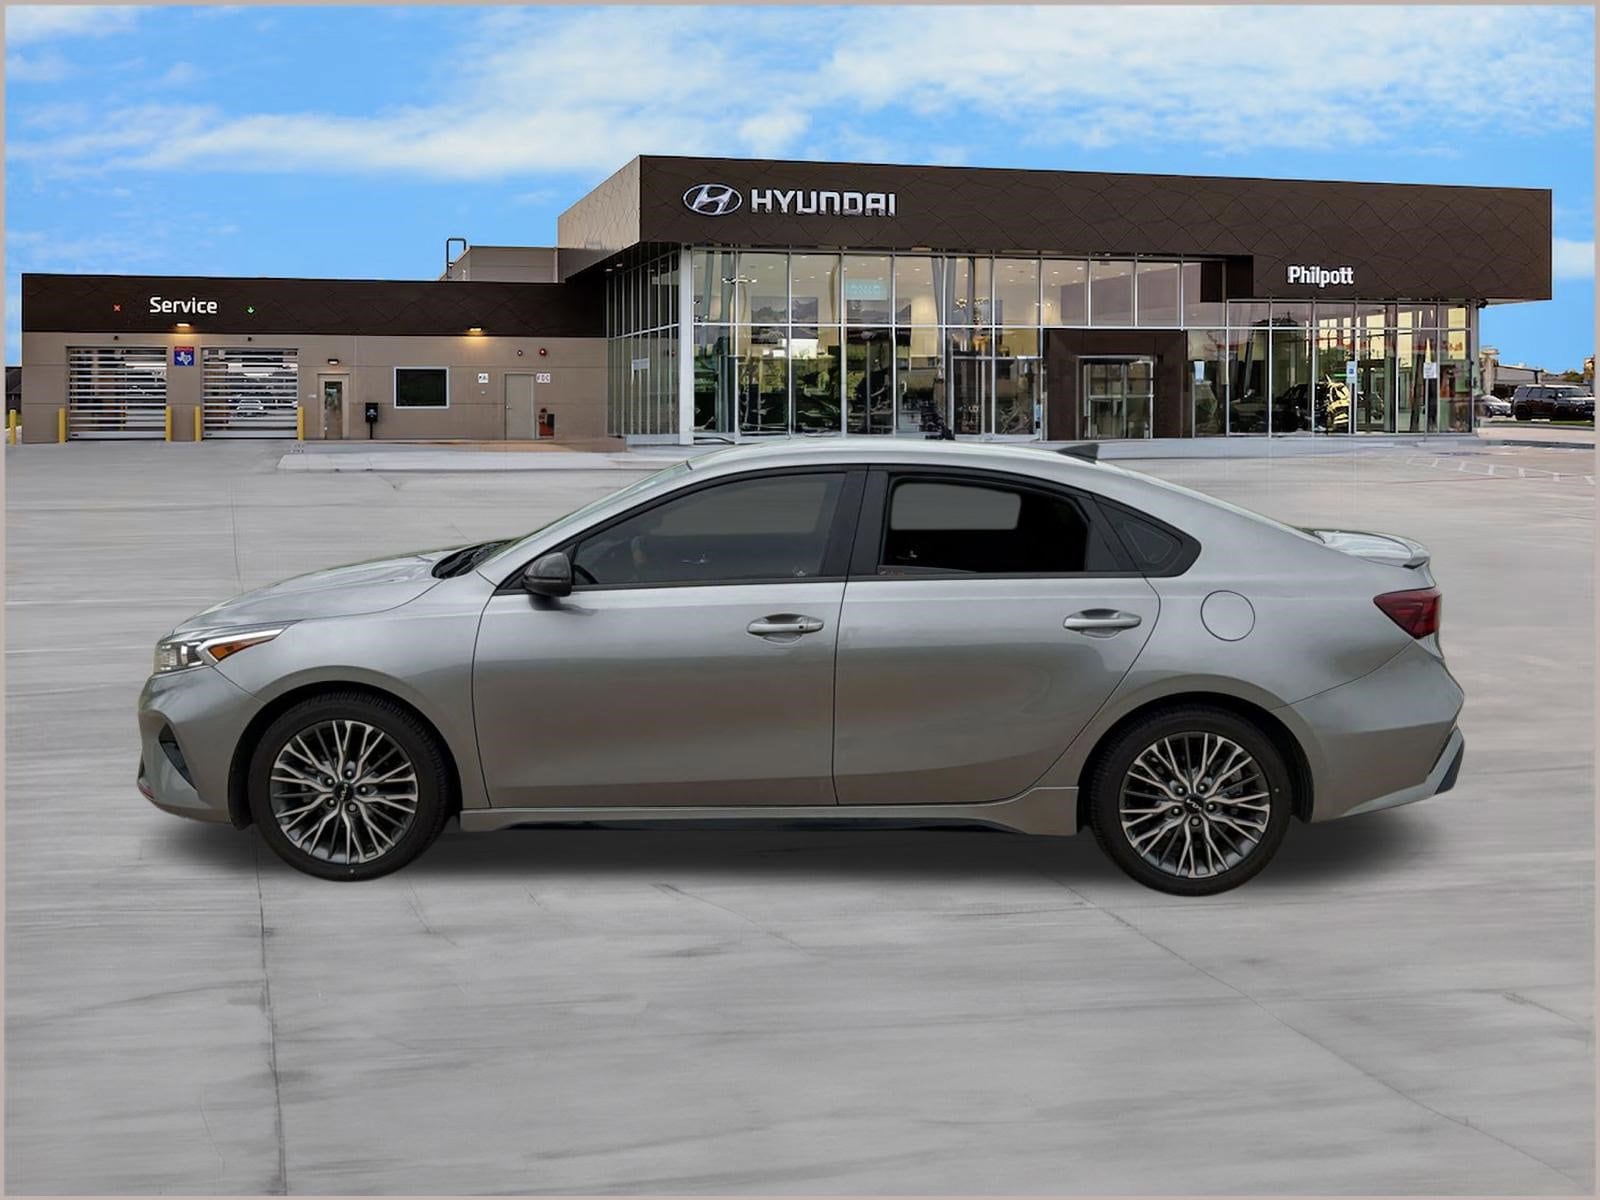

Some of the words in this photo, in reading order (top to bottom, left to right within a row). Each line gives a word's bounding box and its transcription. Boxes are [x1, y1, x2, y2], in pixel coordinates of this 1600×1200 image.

[750, 188, 896, 217] HYUNDAI
[1287, 265, 1354, 288] Philpott
[149, 296, 218, 314] Service
